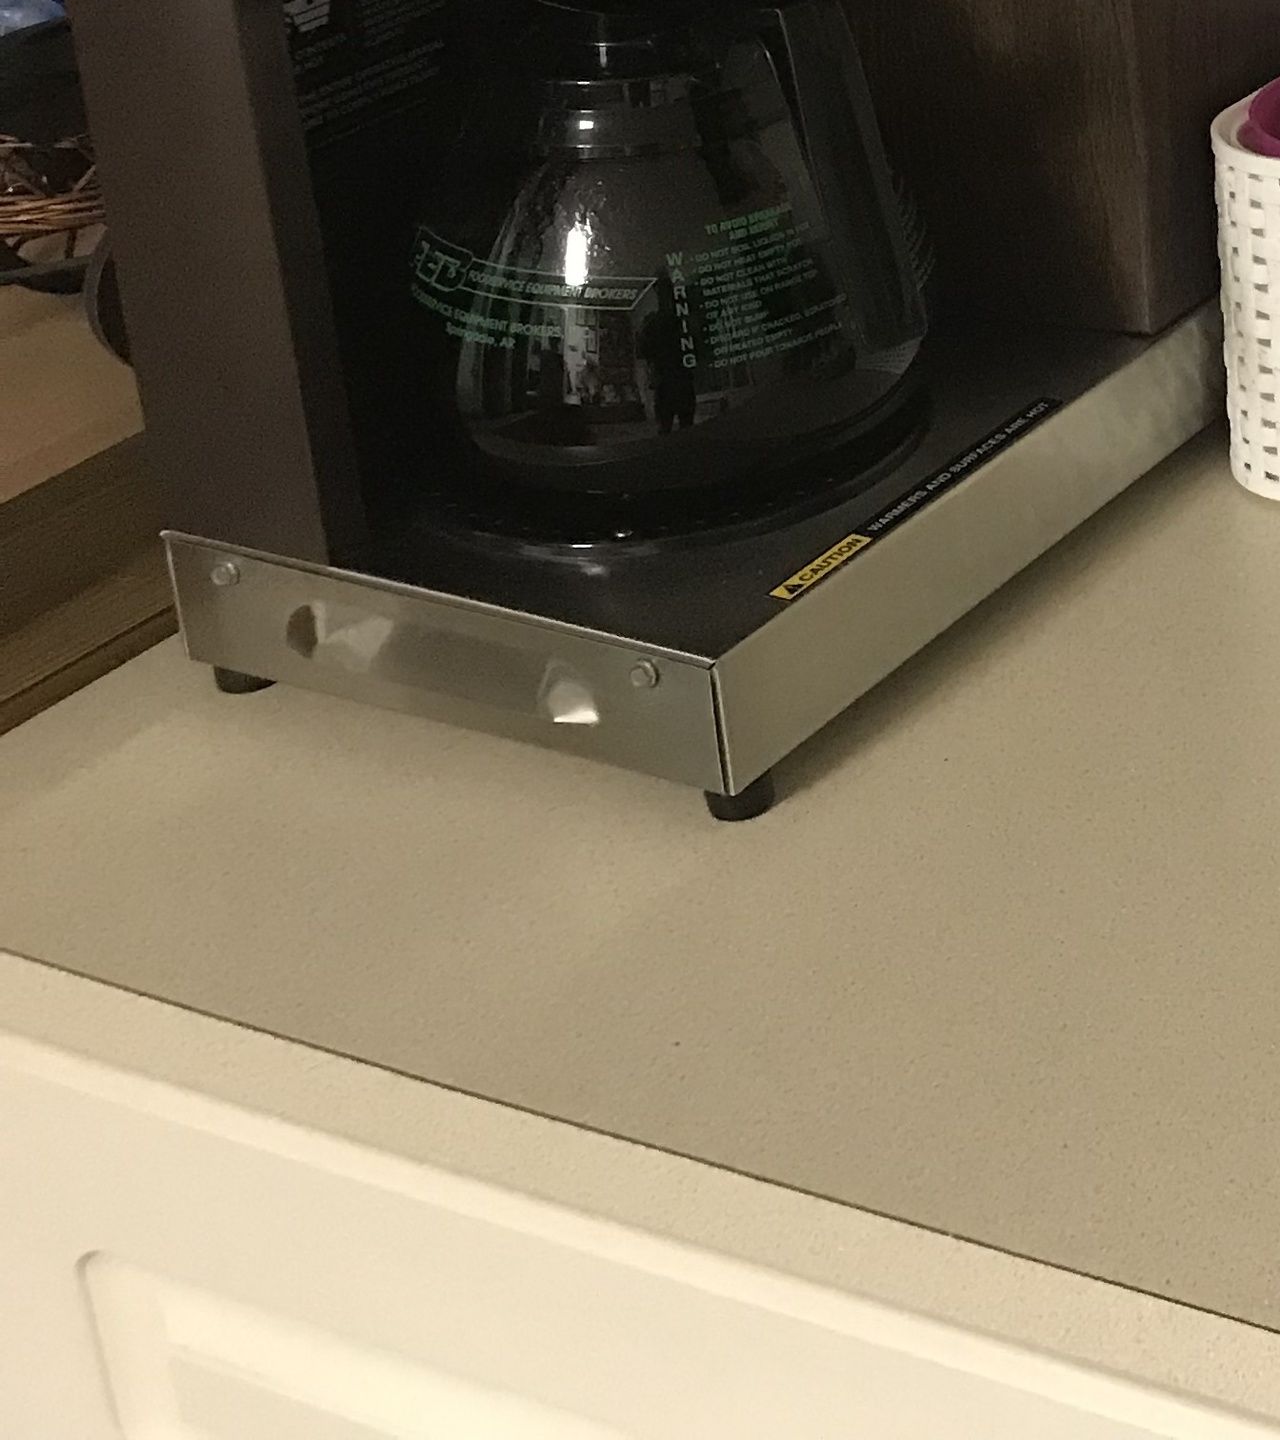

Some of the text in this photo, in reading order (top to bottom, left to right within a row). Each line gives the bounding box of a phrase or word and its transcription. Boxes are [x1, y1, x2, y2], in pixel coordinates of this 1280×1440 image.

[525, 280, 584, 300] EQUIPMENT
[583, 286, 638, 301] BROKERS
[666, 251, 698, 369] WARNING
[867, 401, 1050, 533] WARMERS AND SURFACES ARE HOT
[798, 536, 863, 585] CAUTION
